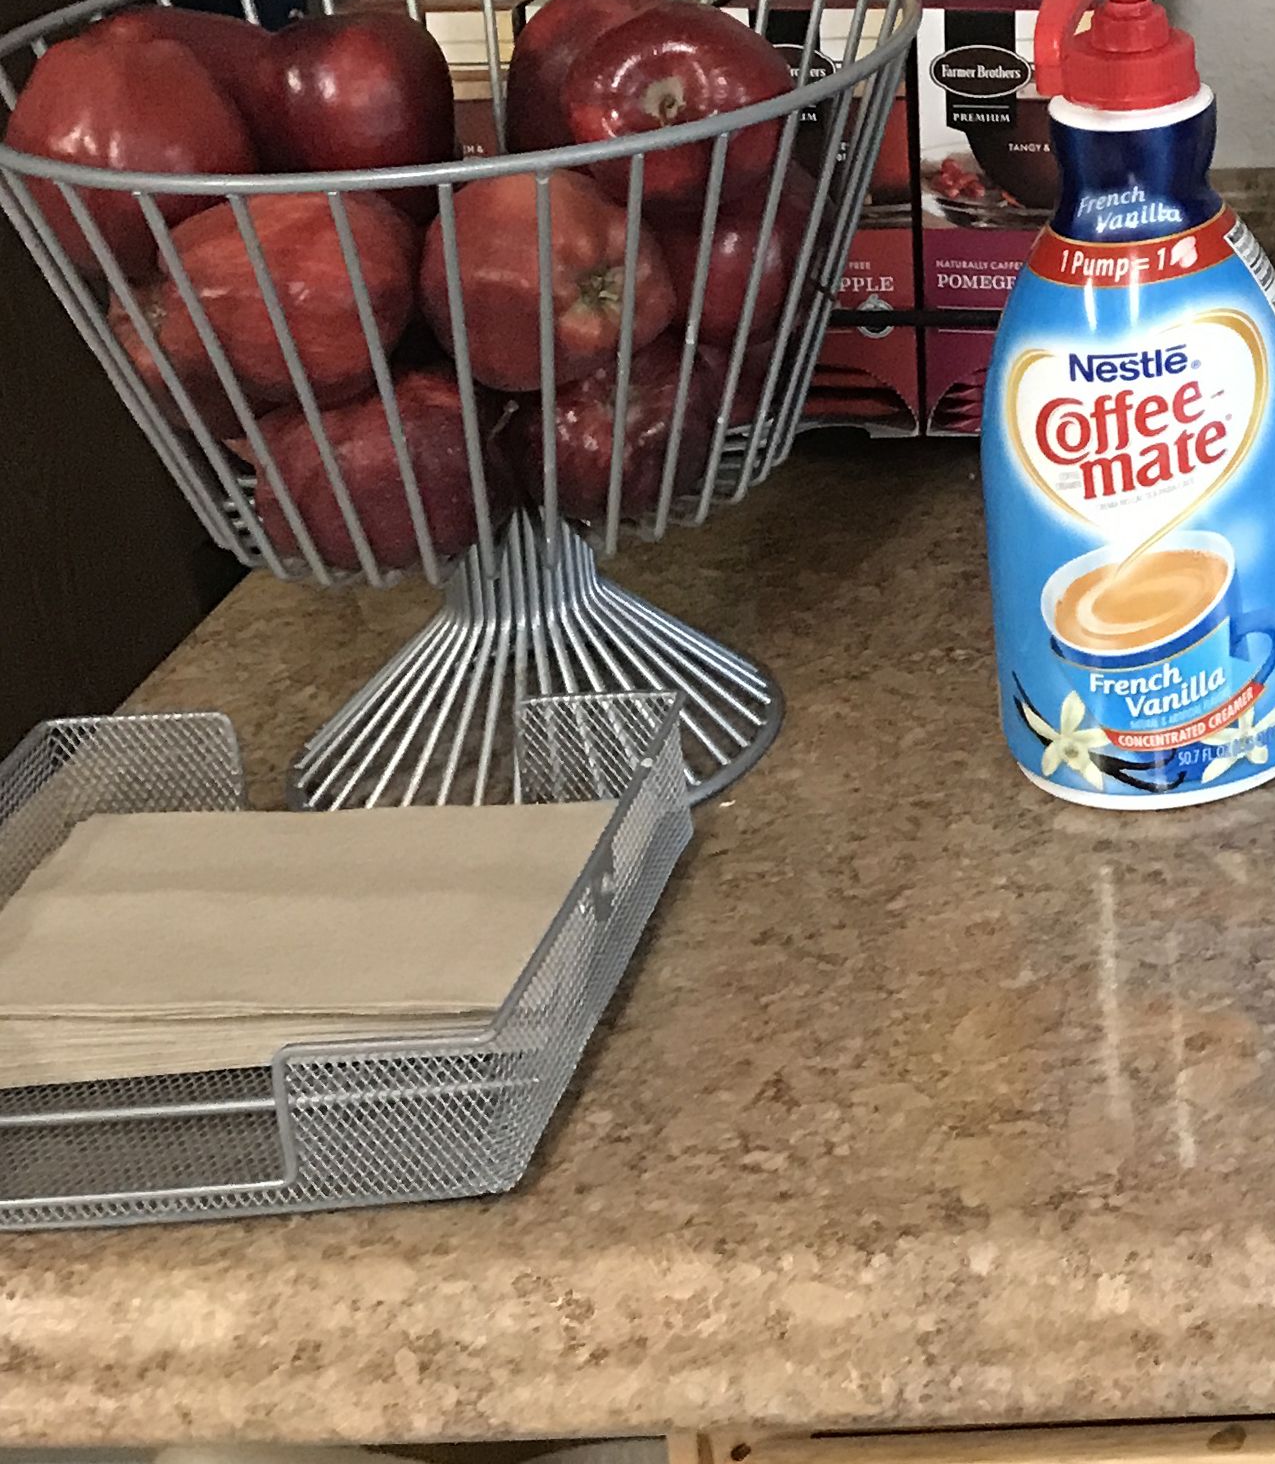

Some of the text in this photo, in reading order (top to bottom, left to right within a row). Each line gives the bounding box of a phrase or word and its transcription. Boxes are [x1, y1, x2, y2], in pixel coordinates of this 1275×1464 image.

[942, 64, 1021, 79] Farmer Brothers
[953, 113, 1010, 123] PREMIUM
[1008, 143, 1042, 153] TANGY
[1077, 185, 1146, 217] French
[1095, 202, 1183, 234] Vanilla
[936, 260, 988, 270] NATURALLY
[1060, 249, 1070, 273] 1
[1071, 250, 1129, 282] Pump
[1157, 247, 1166, 271] 1
[1035, 380, 1205, 466] Coffee
[1079, 419, 1228, 501] mate
[1089, 663, 1183, 696] French
[1125, 666, 1226, 717] Vanilla
[1118, 723, 1206, 748] CONCENTRATED
[1208, 686, 1255, 729] CREAMER
[1178, 748, 1200, 766] 50.7
[1202, 747, 1213, 762] FL
